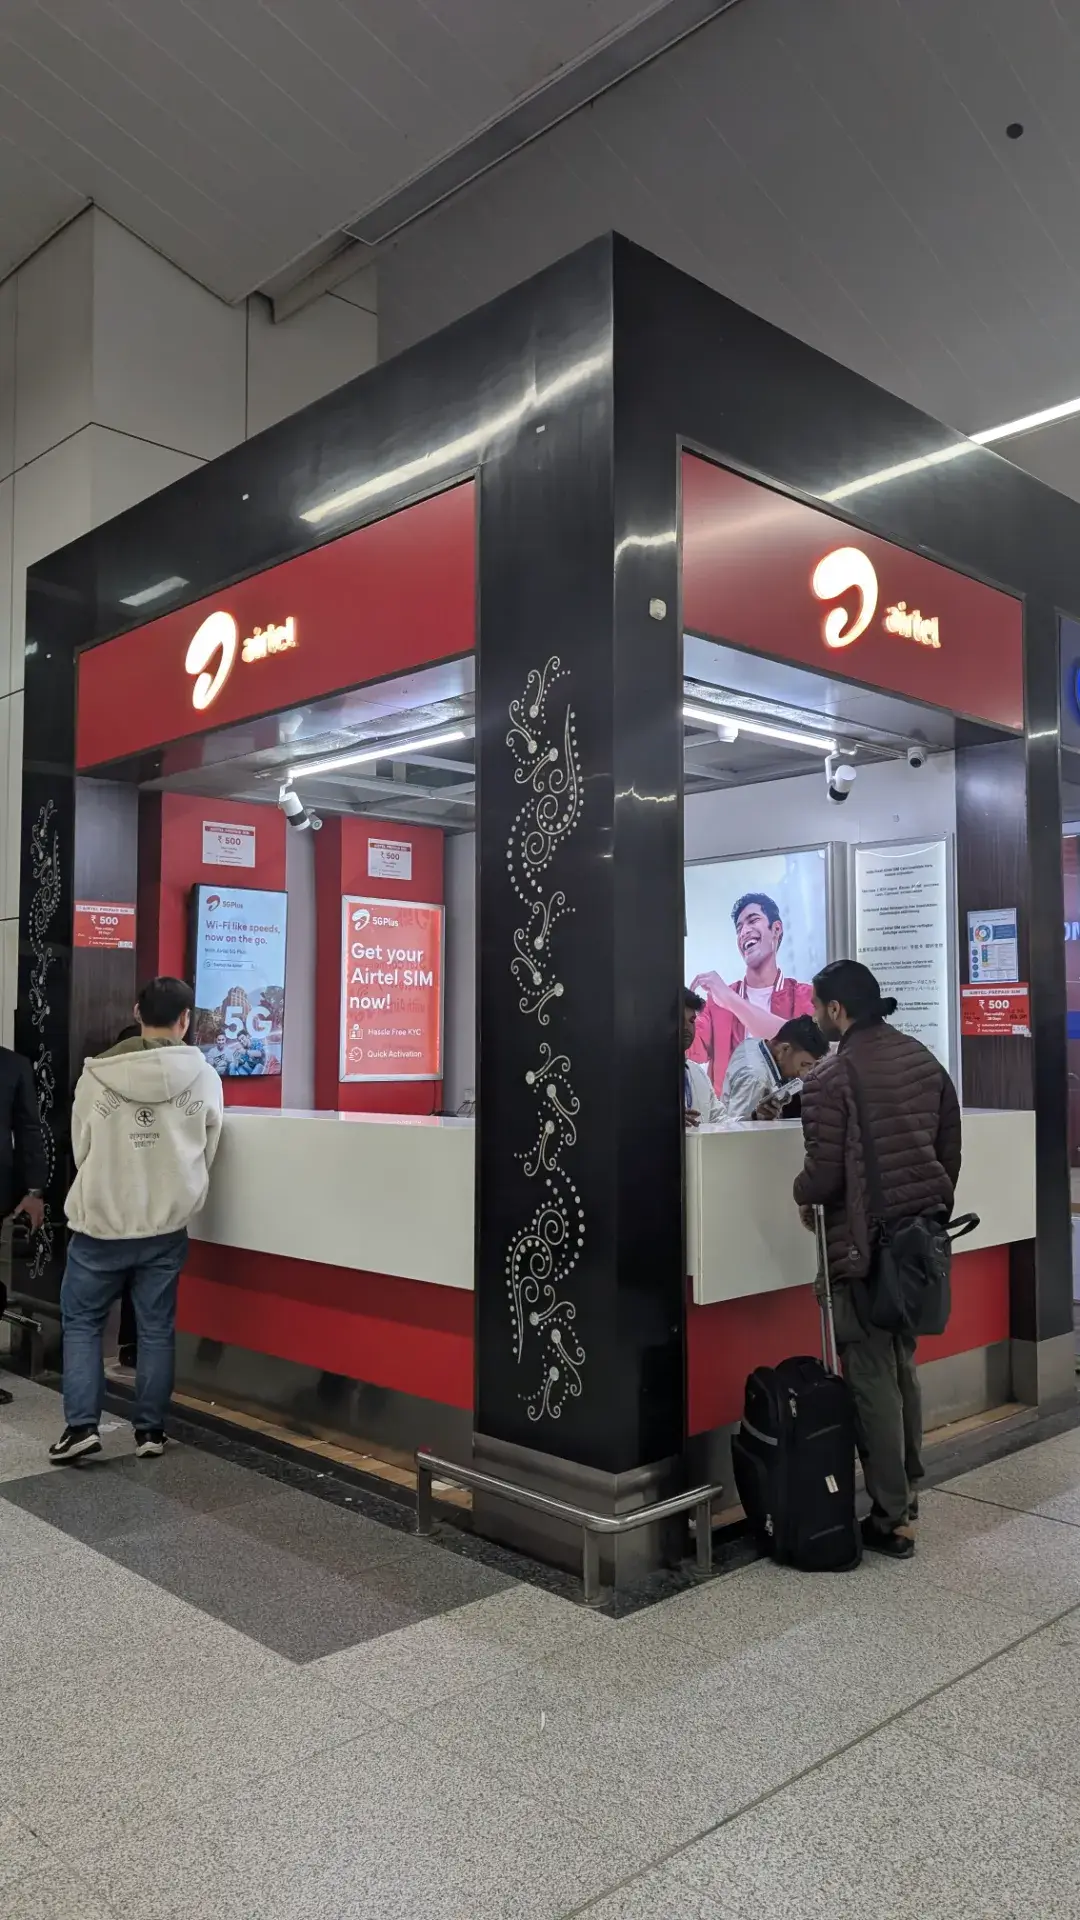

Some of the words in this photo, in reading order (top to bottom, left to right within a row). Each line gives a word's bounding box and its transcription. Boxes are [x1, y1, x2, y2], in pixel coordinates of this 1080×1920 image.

[886, 601, 941, 649] airtel
[242, 616, 298, 663] airtel
[225, 837, 241, 846] 500
[386, 853, 400, 861] 500
[99, 916, 119, 926] 500
[205, 919, 231, 930] Wi-Fi
[232, 922, 247, 931] like
[249, 925, 281, 934] speeds,
[205, 934, 224, 942] now
[225, 935, 237, 943] on
[238, 934, 253, 943] the
[254, 937, 268, 946] go.
[351, 942, 382, 960] Get
[386, 947, 424, 965] your
[351, 967, 398, 986] Airtel
[403, 968, 433, 987] SIM
[349, 993, 391, 1010] now!
[988, 999, 1010, 1009] 500
[224, 1005, 273, 1040] 5G
[367, 1028, 391, 1036] Hassle
[391, 1028, 407, 1036] Free
[408, 1028, 422, 1036] KYC
[367, 1050, 388, 1059] Quick
[388, 1050, 422, 1059] Activation
